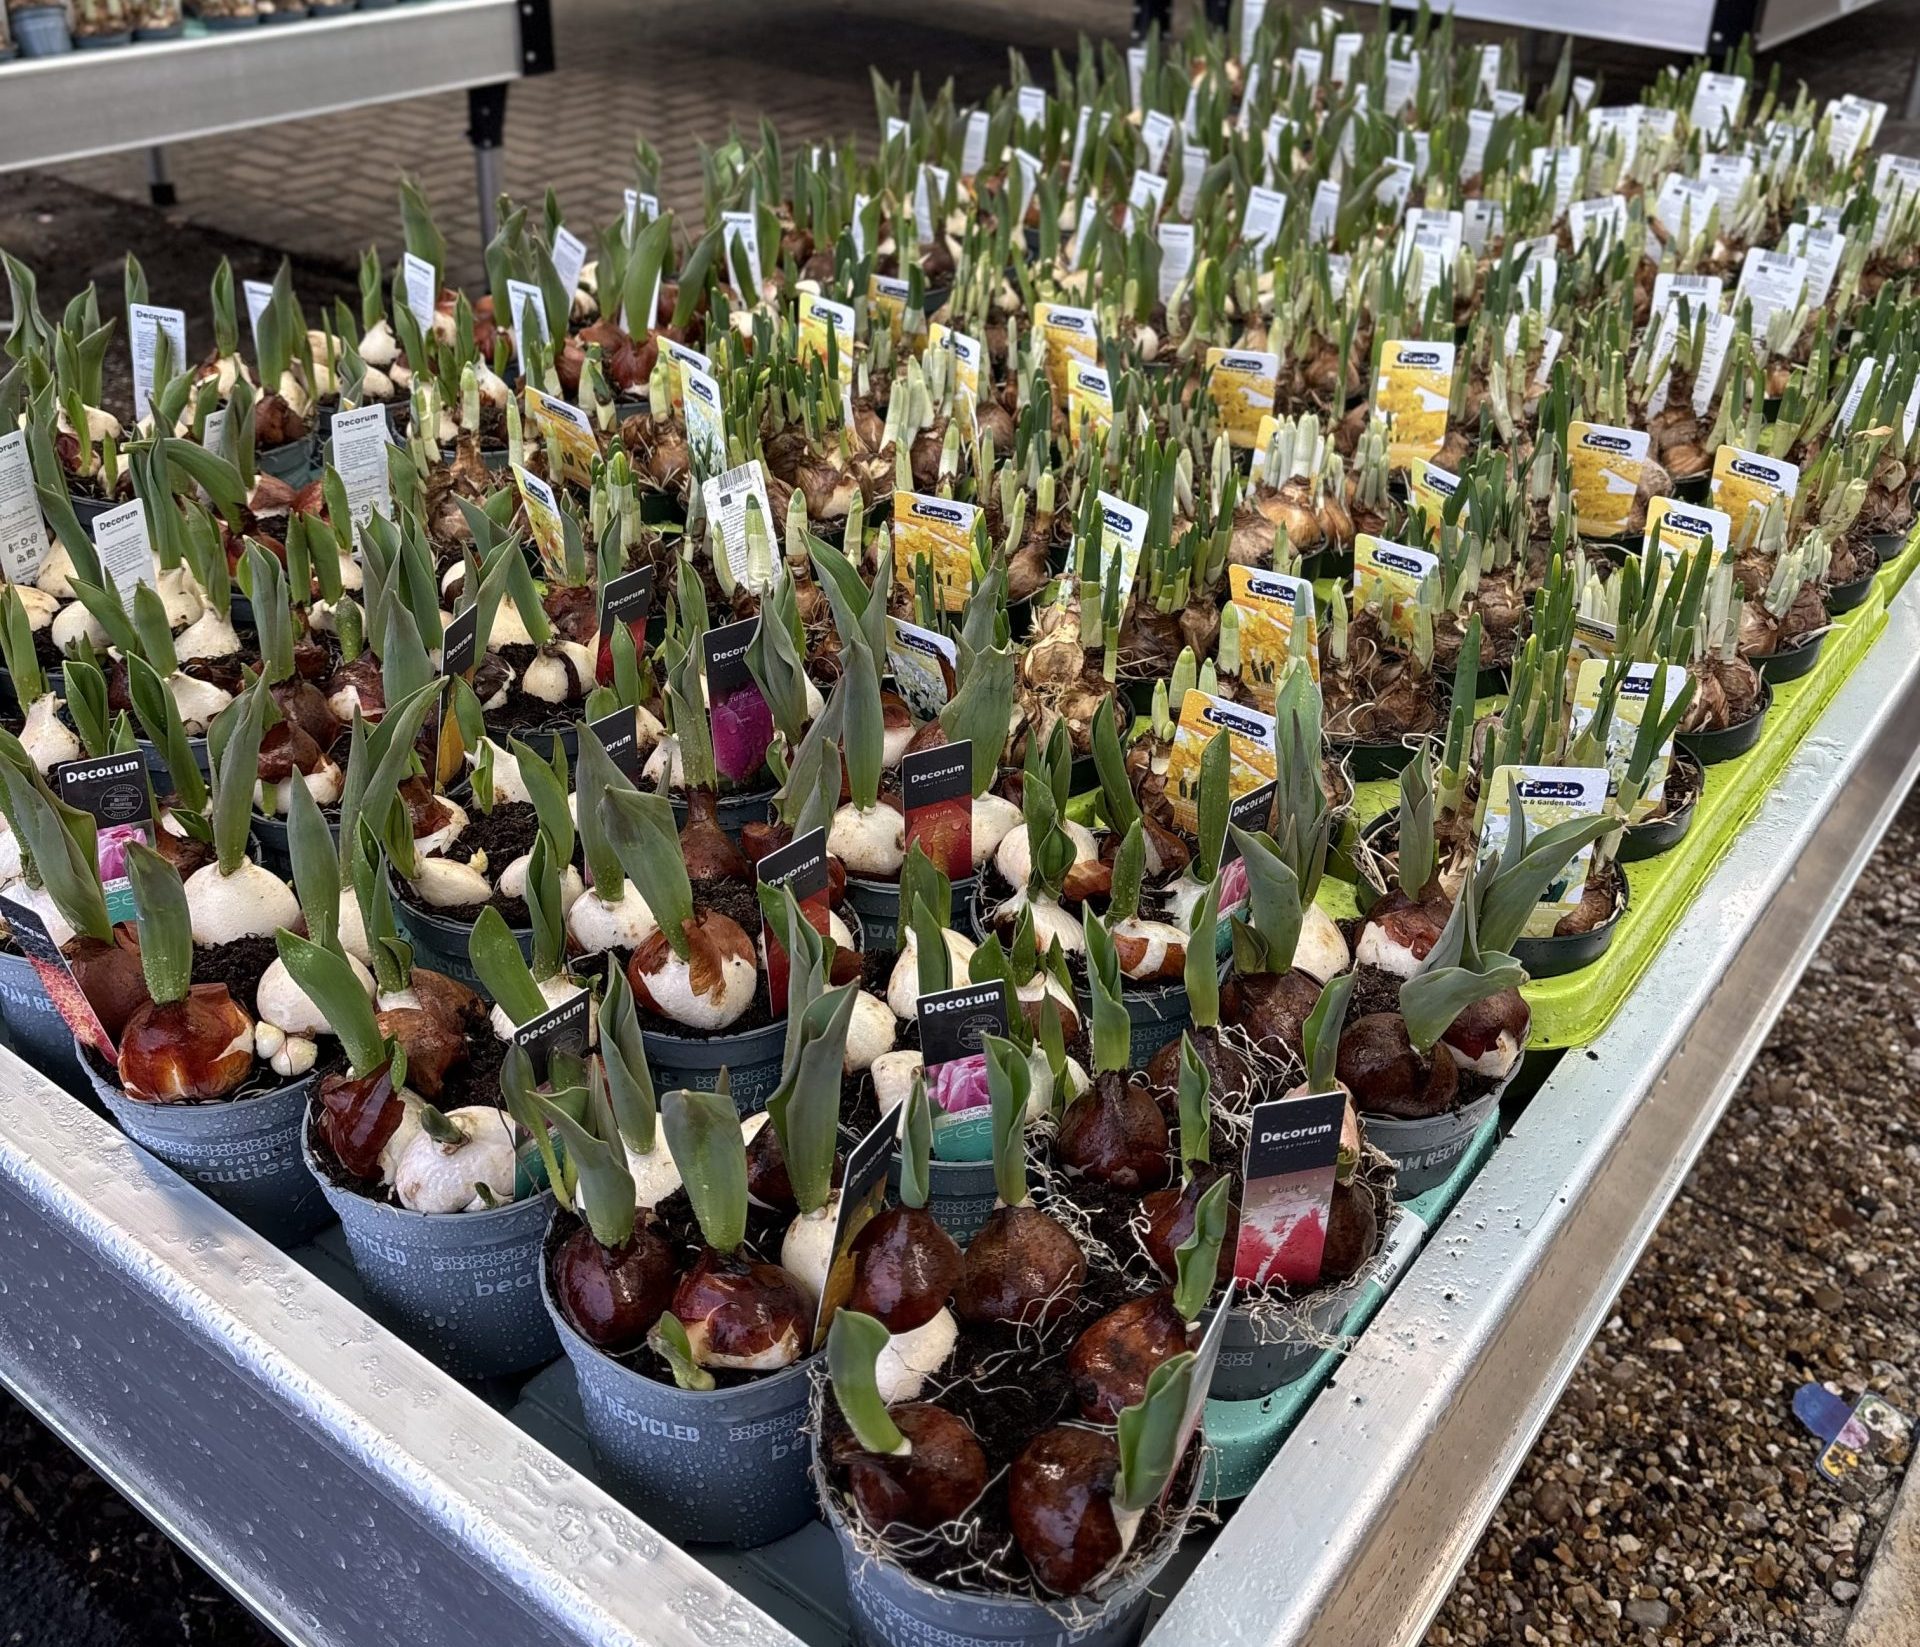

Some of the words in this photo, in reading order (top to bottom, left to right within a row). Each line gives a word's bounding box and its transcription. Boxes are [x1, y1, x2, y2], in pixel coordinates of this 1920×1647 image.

[337, 413, 379, 428] Decorum
[0, 440, 20, 454] orum
[100, 509, 138, 531] Decorum
[608, 588, 646, 610] Decorum
[712, 643, 750, 662] Decoru
[1229, 730, 1248, 739] arden
[1249, 736, 1268, 747] Bulbs
[66, 761, 139, 784] Decorum
[911, 763, 965, 784] Decorum
[925, 809, 952, 820] TULIPA
[1233, 791, 1273, 818] Decorum
[924, 991, 1000, 1015] Decorum
[520, 1001, 585, 1046] Decorum
[1260, 1123, 1332, 1144] Decorum
[208, 1158, 218, 1168] &
[224, 1144, 292, 1167] GARDEN
[1386, 1239, 1400, 1254] Mix
[473, 1262, 523, 1280] HOME
[1379, 1263, 1398, 1284] Extra
[606, 1394, 700, 1444] RECYCLED
